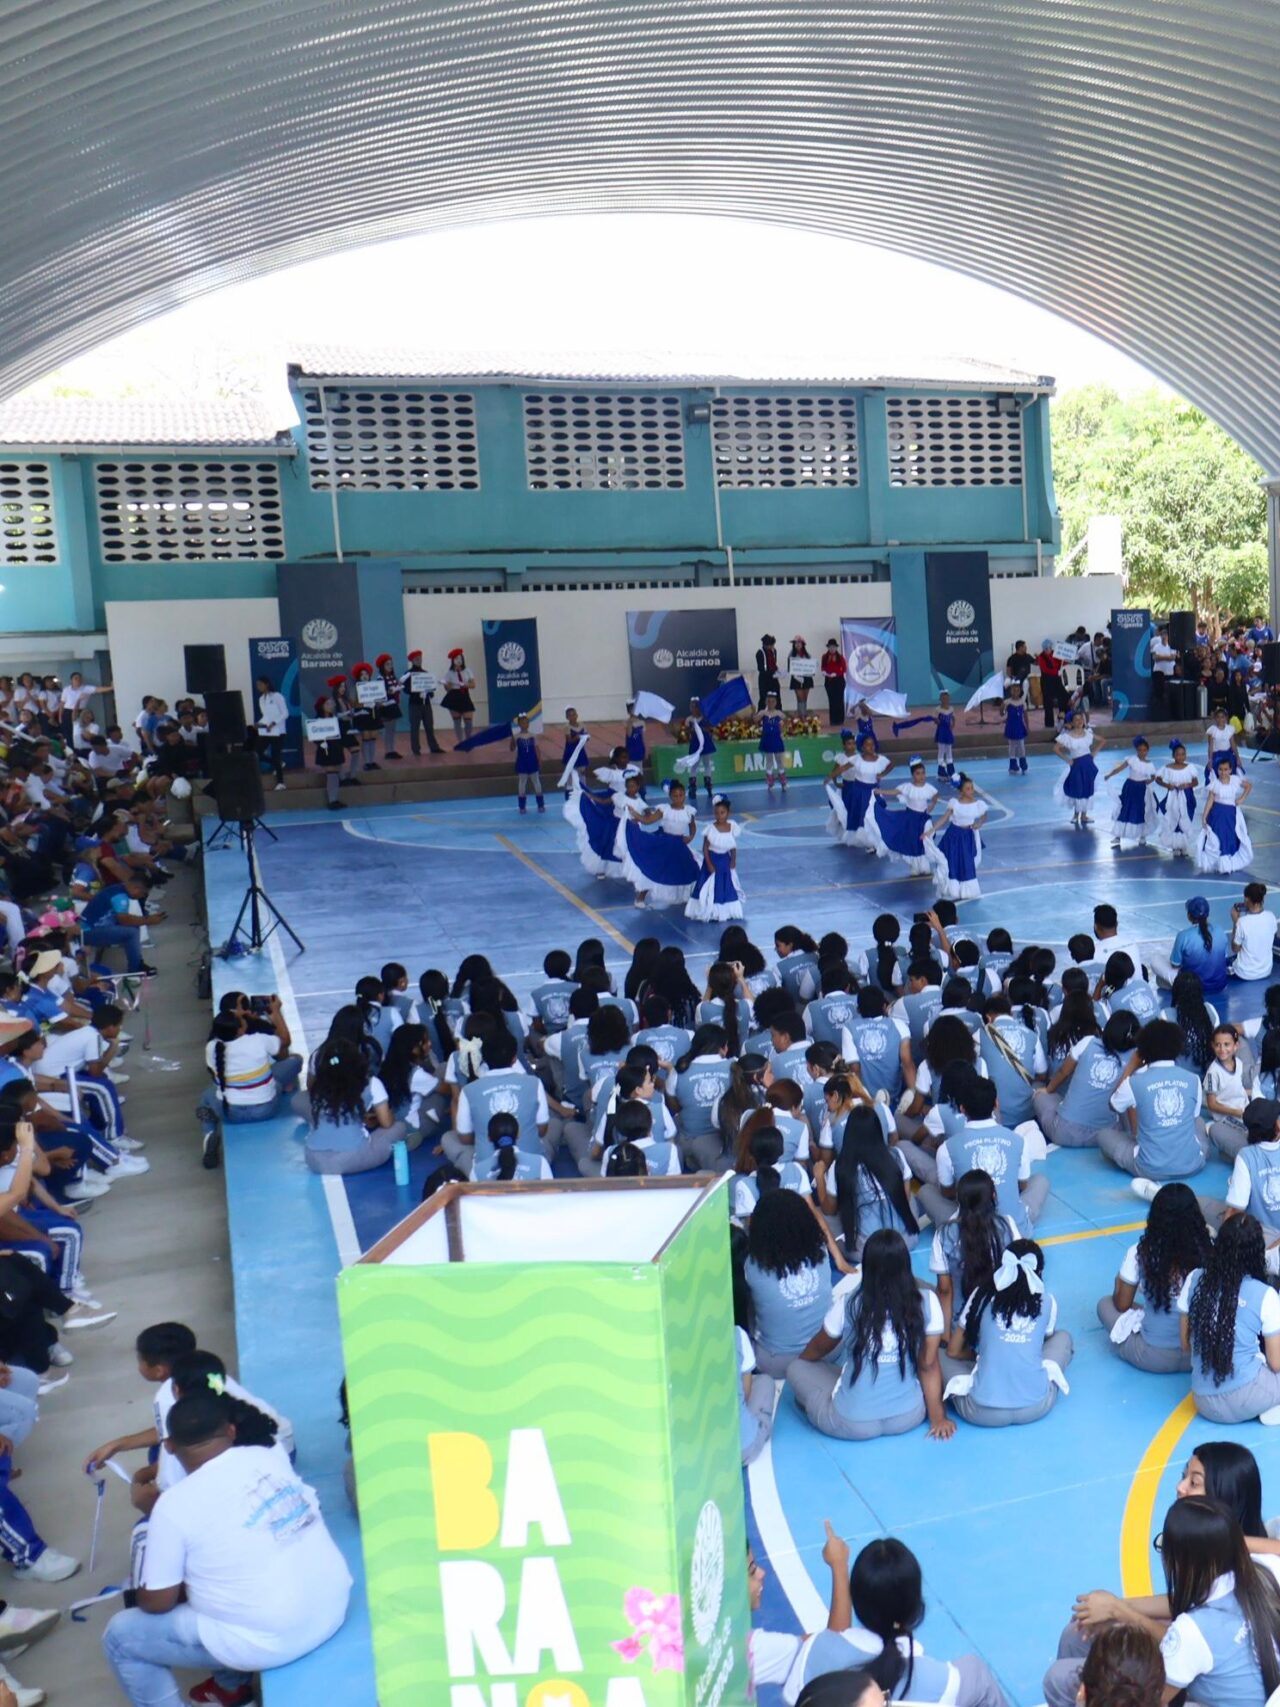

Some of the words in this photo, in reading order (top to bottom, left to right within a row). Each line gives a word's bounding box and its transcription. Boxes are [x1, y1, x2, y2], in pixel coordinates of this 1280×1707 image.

[945, 636, 979, 644] Baranoa
[676, 648, 706, 658] Alcaldía
[709, 649, 720, 657] de
[301, 660, 344, 668] Baranoa
[676, 658, 721, 668] Baranoa
[496, 679, 530, 687] Baranoa
[1147, 1081, 1163, 1092] PROM
[1164, 1080, 1188, 1089] PLATINO
[964, 1138, 982, 1149] PROM
[983, 1137, 1011, 1147] PLATINO
[428, 1428, 572, 1552] BA
[438, 1556, 584, 1678] RA
